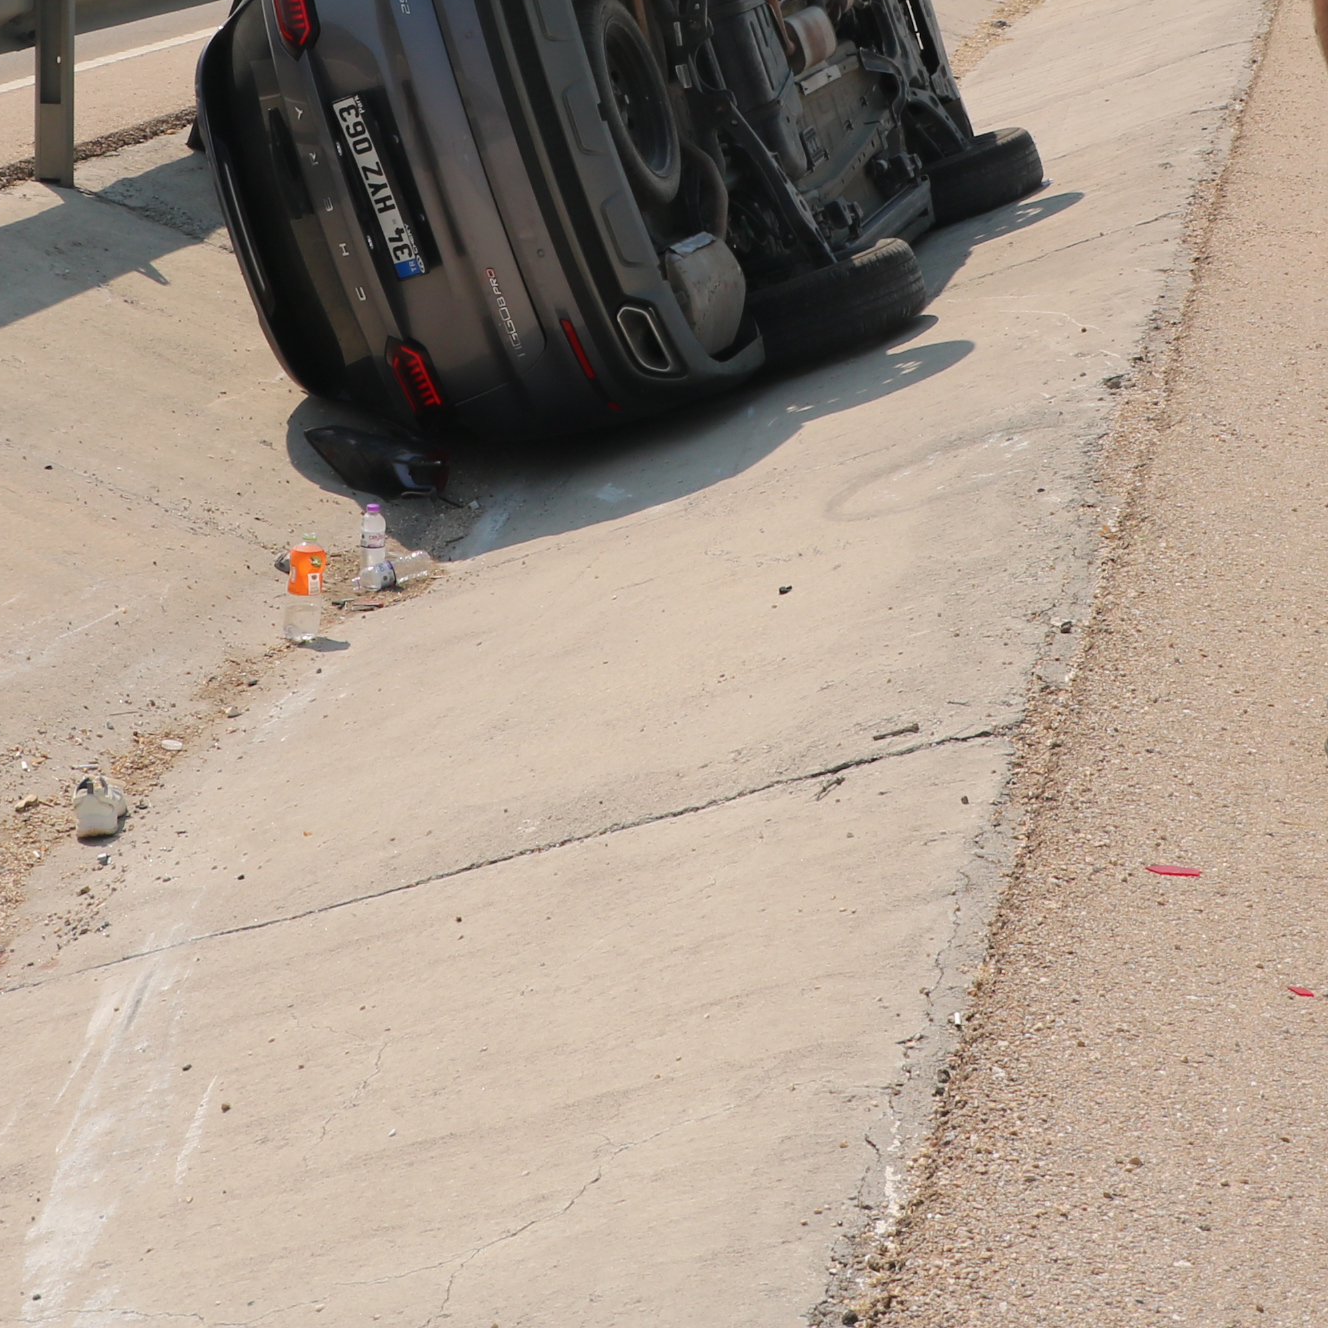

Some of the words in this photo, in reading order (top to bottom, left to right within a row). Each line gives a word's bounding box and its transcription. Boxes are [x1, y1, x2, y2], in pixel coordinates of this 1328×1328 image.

[338, 103, 373, 156] 063
[361, 160, 397, 214] HYZ
[387, 225, 413, 262] 34
[409, 260, 418, 273] TR
